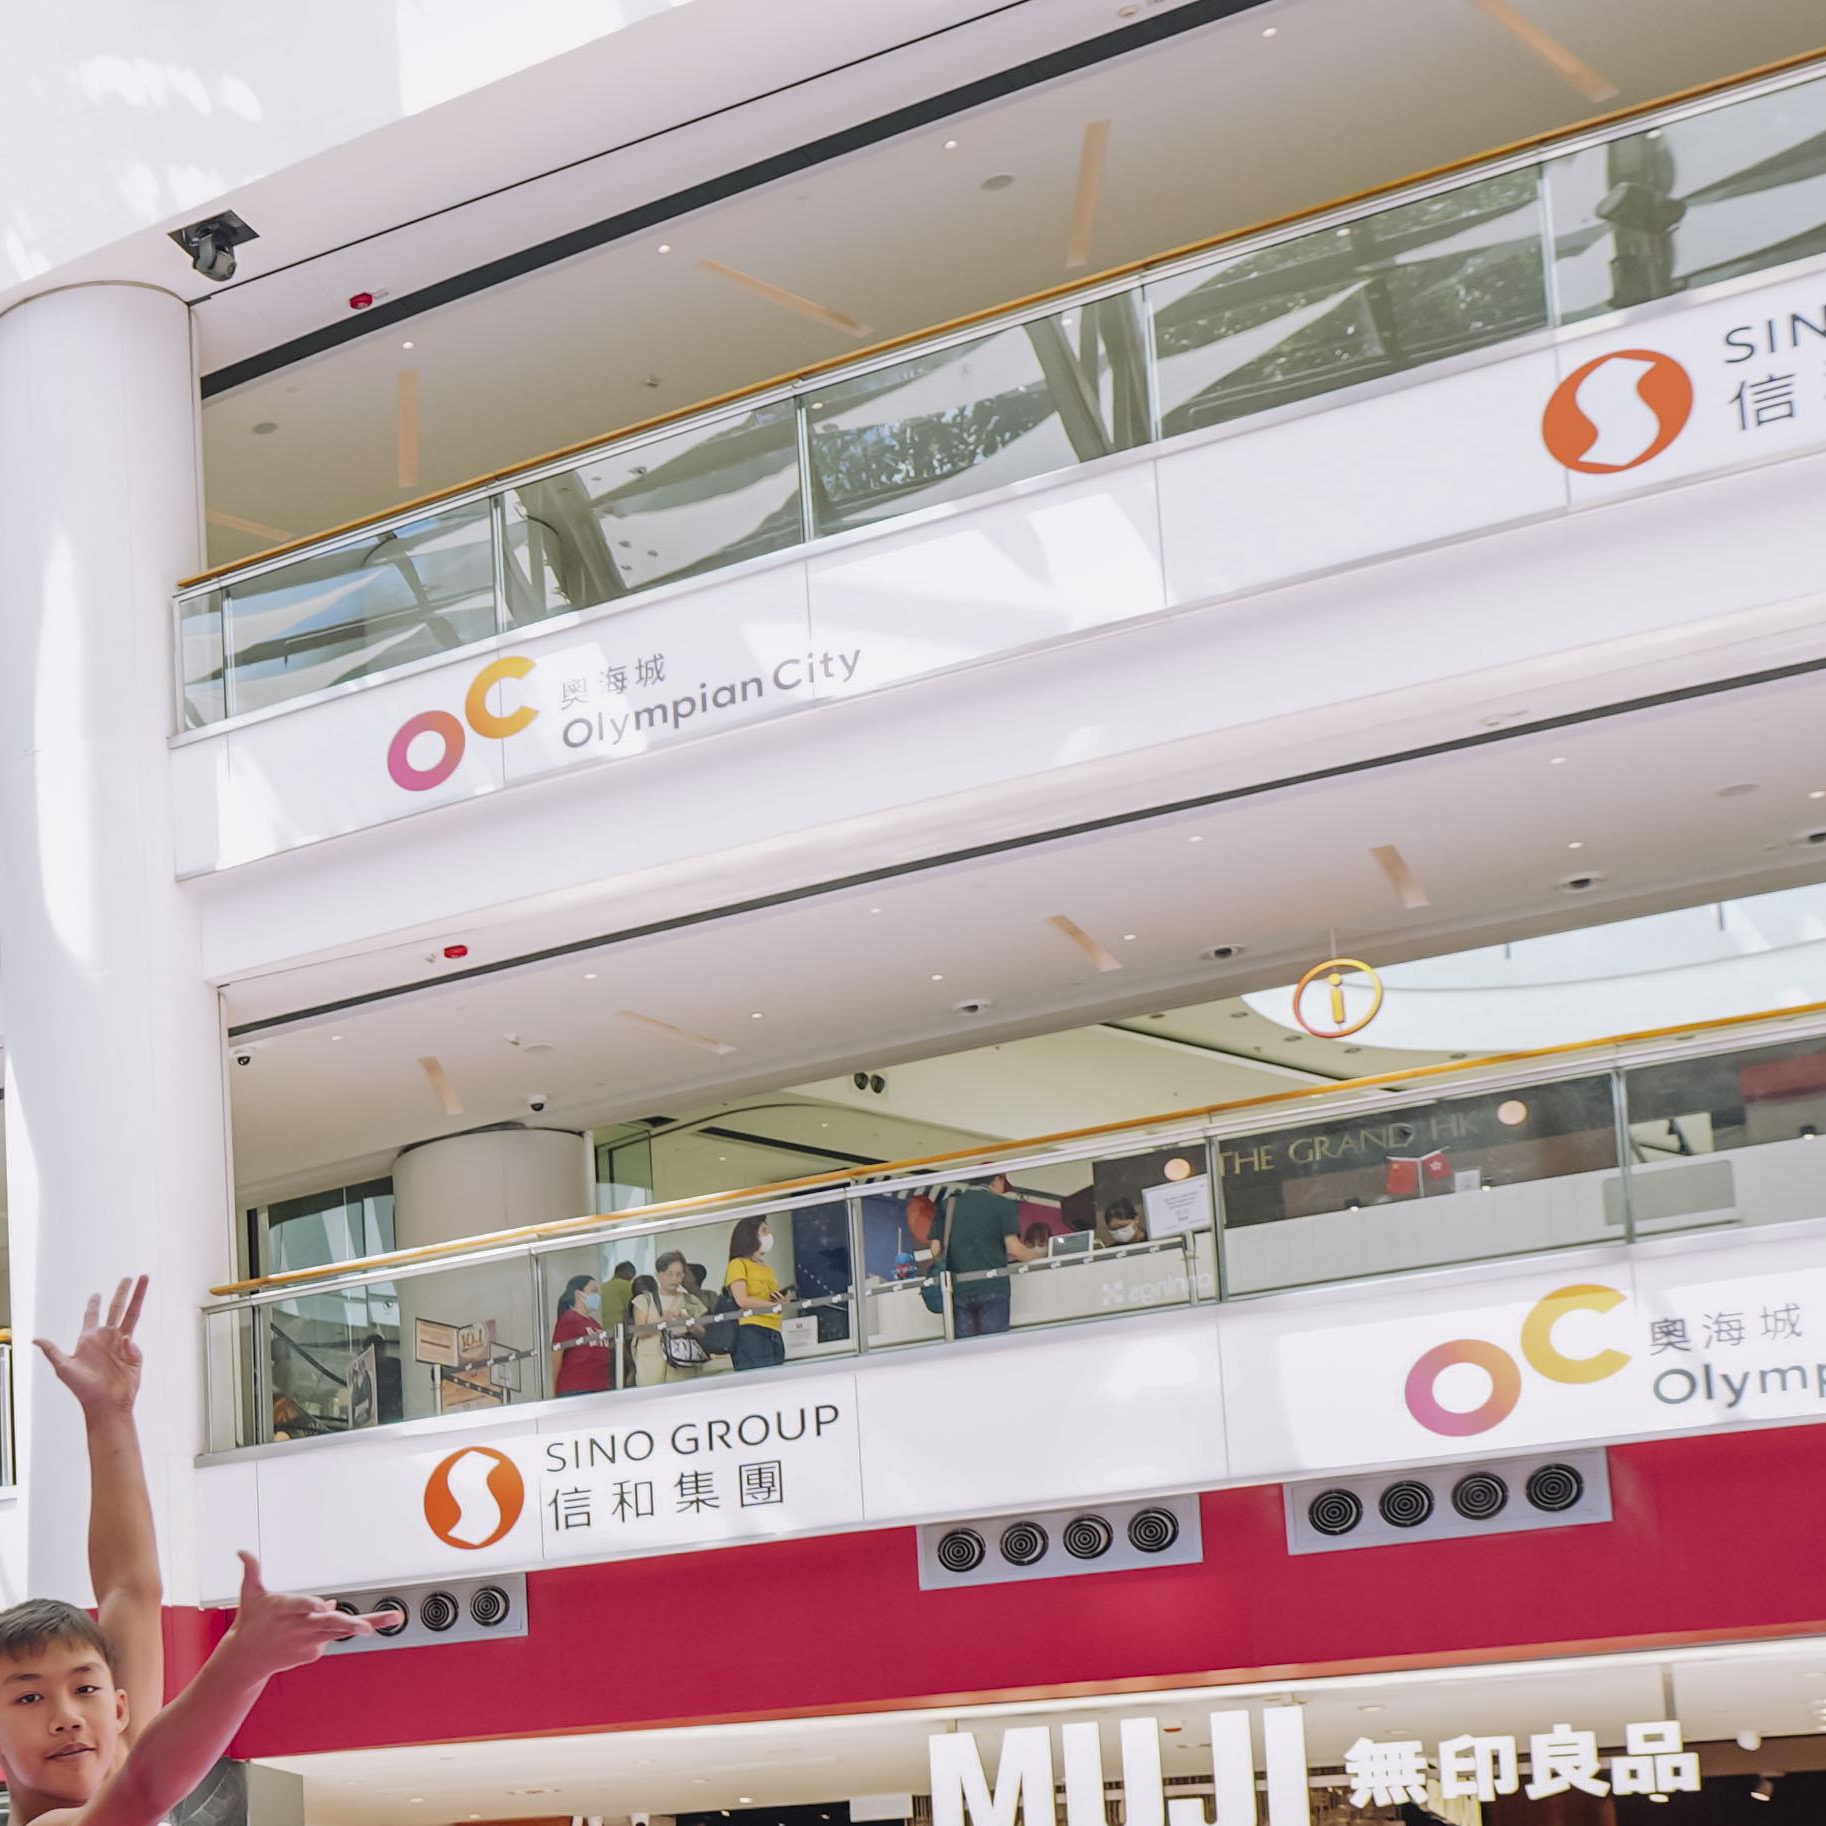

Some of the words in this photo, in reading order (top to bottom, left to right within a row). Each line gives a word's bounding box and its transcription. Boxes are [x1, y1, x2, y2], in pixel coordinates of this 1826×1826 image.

[387, 655, 539, 792] OC
[562, 677, 764, 749] Olympian
[772, 649, 862, 694] City
[1219, 1144, 1275, 1176] THE
[1289, 1123, 1413, 1163] GRAND
[1405, 1284, 1633, 1437] OC
[546, 1430, 654, 1473] SINO
[671, 1404, 839, 1455] GROUP
[547, 1460, 784, 1531] 信和集團
[1344, 1720, 1702, 1809] 無印良品
